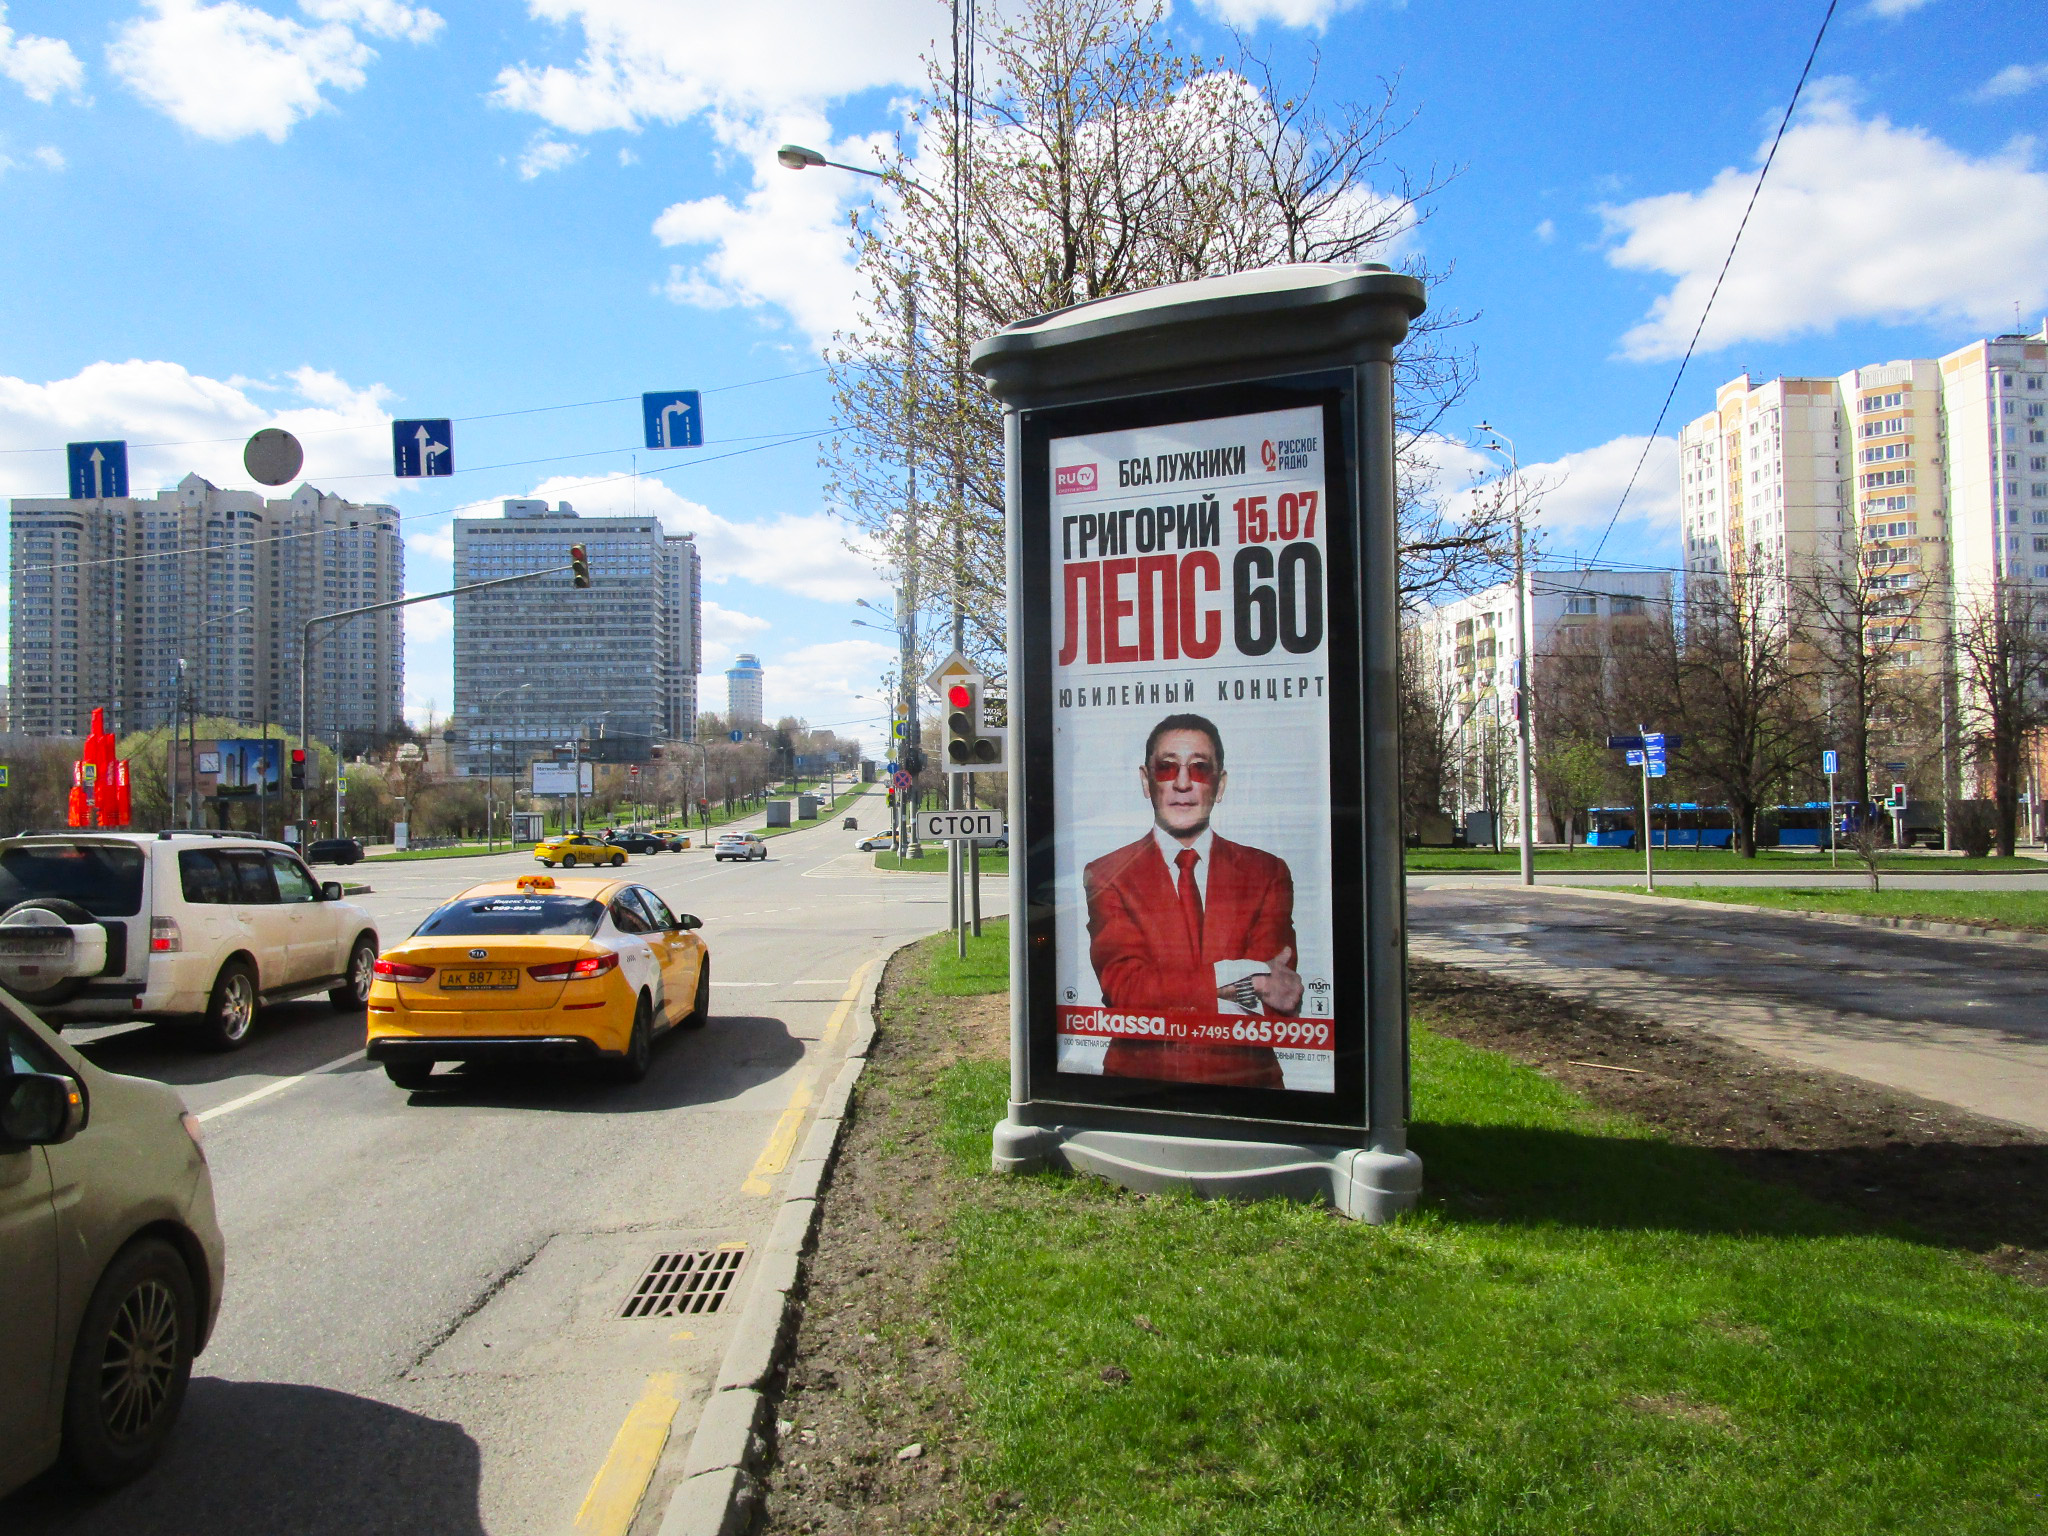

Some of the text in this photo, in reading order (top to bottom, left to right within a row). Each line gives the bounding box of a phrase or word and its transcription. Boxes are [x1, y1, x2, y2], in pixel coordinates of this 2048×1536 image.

[1278, 437, 1317, 454] РУССКОЕ
[1119, 446, 1246, 487] БСА ЛУЖНИКИ
[1278, 454, 1308, 470] РАДИО
[1058, 473, 1091, 485] RU TV
[1063, 491, 1319, 560] ГРИГОРИЙ 15.07
[1059, 542, 1323, 666] ЛЕПС 60
[1059, 676, 1324, 708] ЮБИЛЕЙНЫЙ КОНЦЕРТ
[929, 816, 991, 835] СТОП
[469, 972, 493, 984] 887
[501, 970, 513, 980] 23
